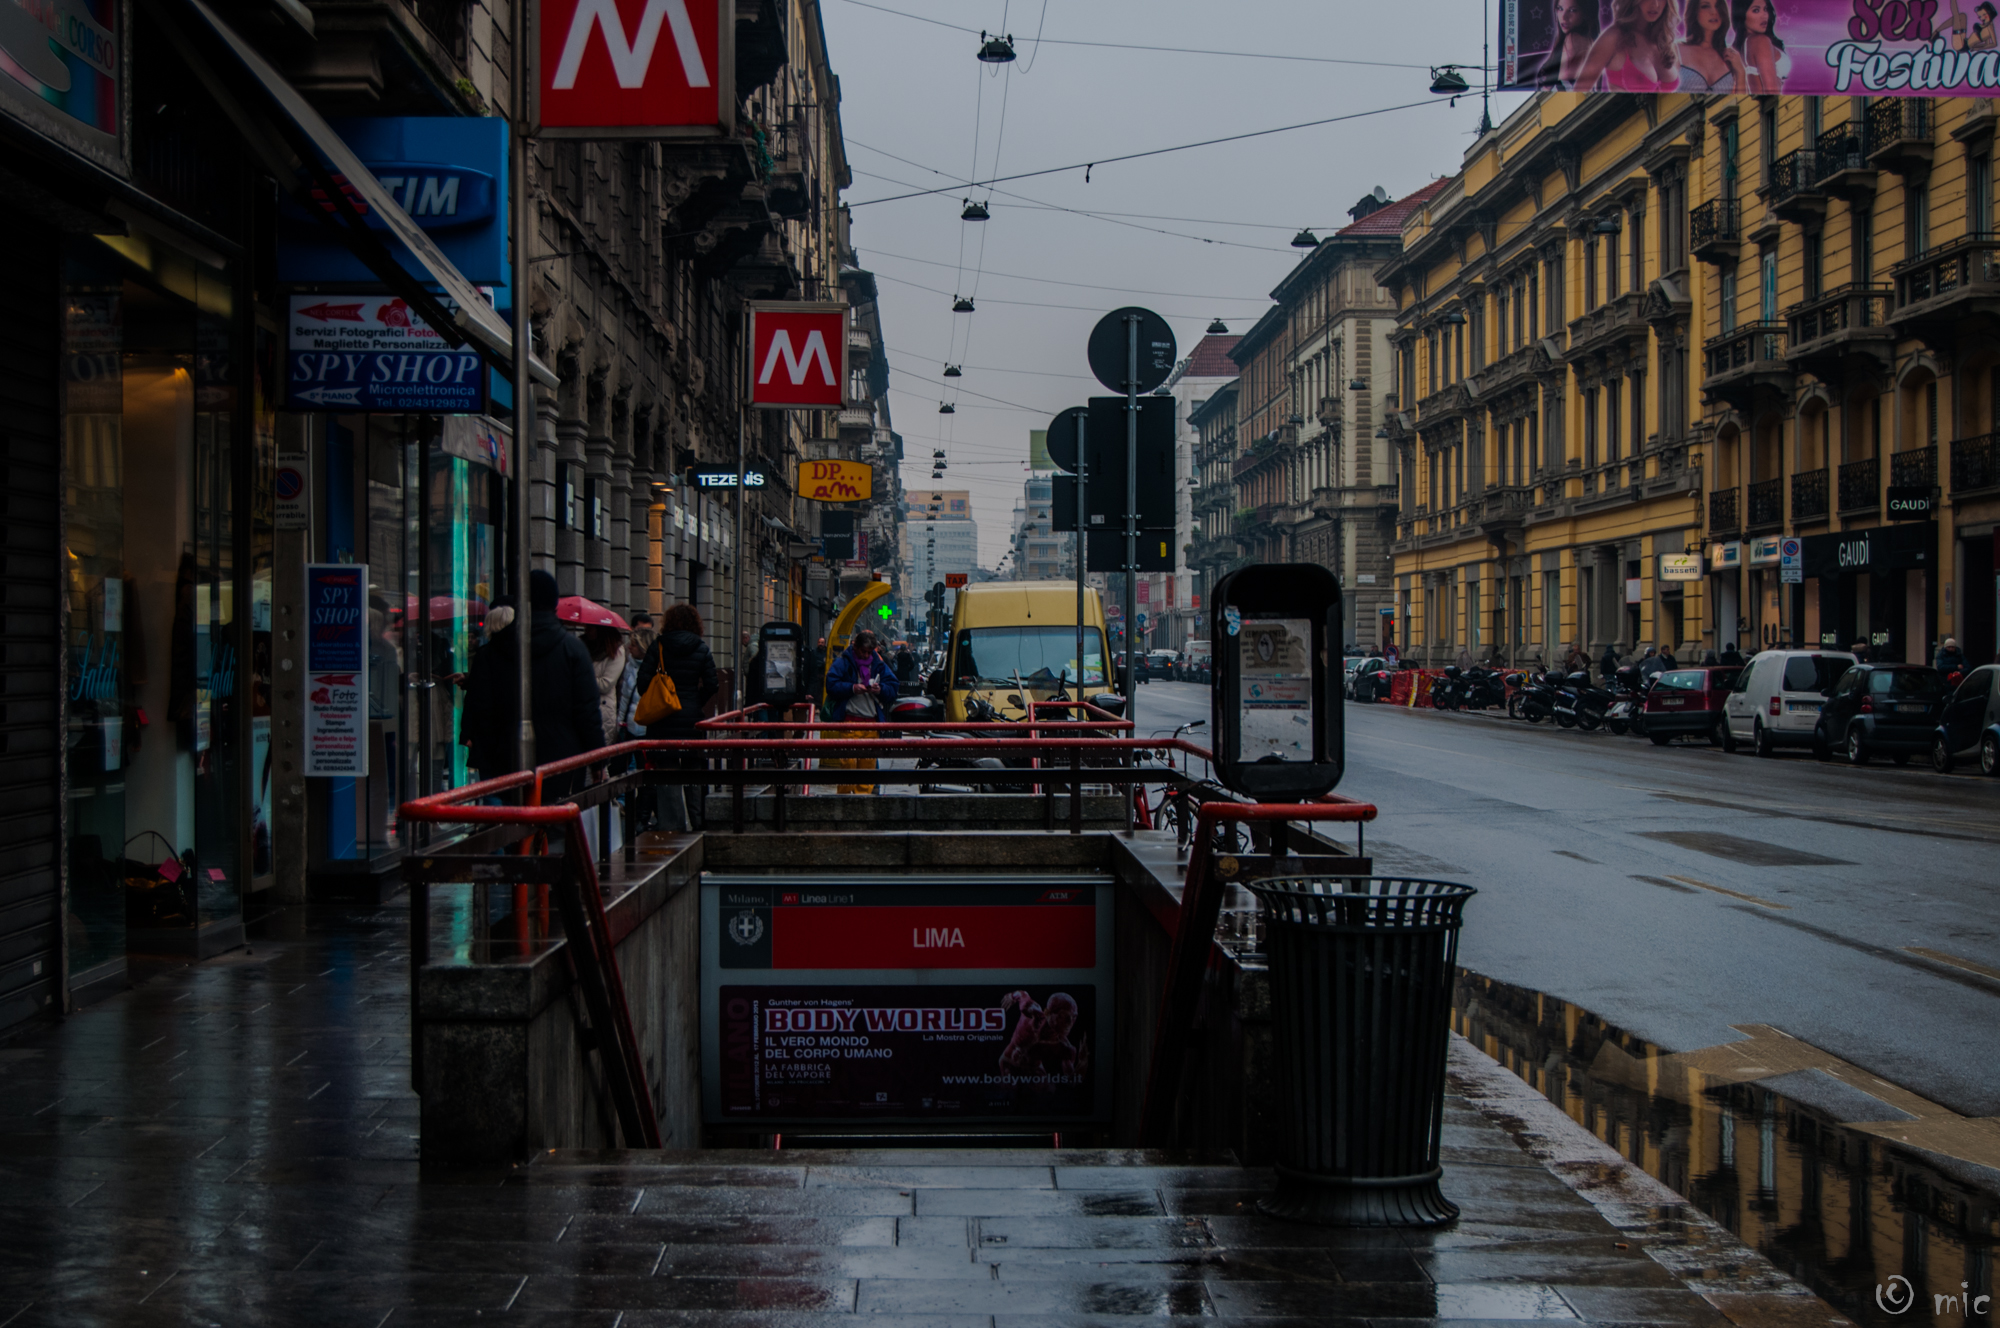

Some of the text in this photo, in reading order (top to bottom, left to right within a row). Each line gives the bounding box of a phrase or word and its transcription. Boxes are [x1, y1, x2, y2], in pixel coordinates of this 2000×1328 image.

[1848, 0, 1938, 41] Sex
[69, 15, 114, 70] CORSO
[551, 0, 711, 90] M
[384, 176, 460, 216] TIM
[325, 309, 356, 317] CORTILE
[295, 327, 337, 337] Servizi
[340, 327, 405, 339] Fotografici
[314, 339, 370, 350] Magliette
[758, 329, 837, 387] M
[293, 353, 479, 383] SPY SHOP
[322, 392, 353, 400] PIANO
[369, 383, 476, 396] Microelettronica
[376, 398, 470, 409] Tel. 02/43129873
[812, 463, 863, 481] DP...
[813, 482, 861, 499] am
[1890, 497, 1930, 511] GAUDÌ
[1838, 532, 1869, 567] GAUDÌ
[1664, 566, 1697, 574] bassetti
[947, 576, 968, 585] TAXI
[321, 587, 353, 605] SPY
[314, 607, 359, 625] SHOP
[333, 689, 358, 700] Foto
[728, 894, 764, 904] Milano
[801, 894, 827, 904] Linea
[828, 894, 848, 904] Line
[849, 894, 854, 903] 1
[913, 927, 966, 948] LIMA
[764, 1008, 1006, 1032] BODY WORLDS
[765, 1036, 870, 1046] IL VERO MONDO
[967, 1034, 1003, 1043] Originale
[765, 1048, 893, 1059] DEL CORPO UMANO
[765, 1063, 831, 1071] LA FABBRICA
[765, 1071, 831, 1079] DEL VAPORE
[942, 1073, 1083, 1085] www.bodyworlds.it
